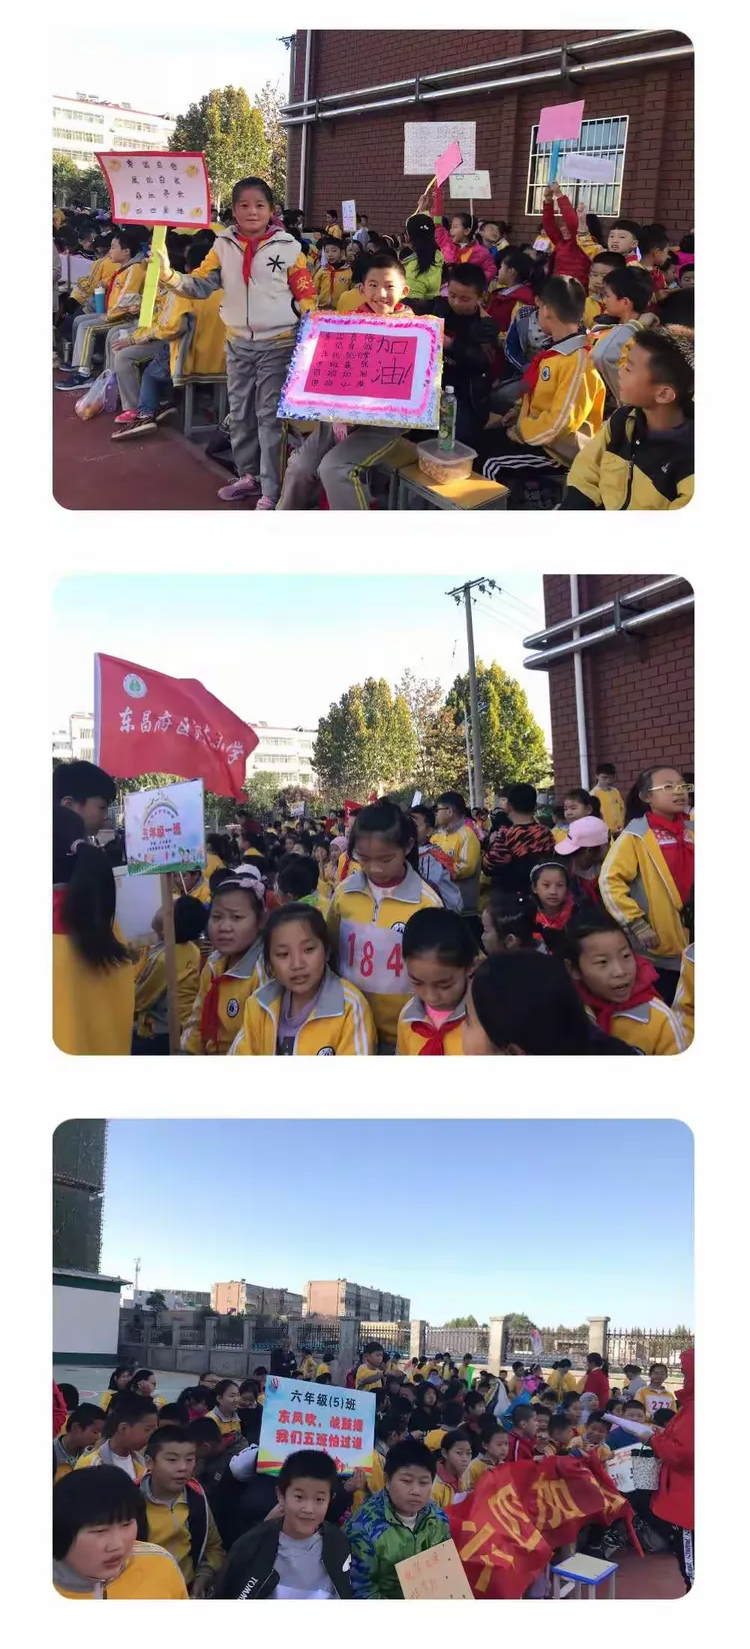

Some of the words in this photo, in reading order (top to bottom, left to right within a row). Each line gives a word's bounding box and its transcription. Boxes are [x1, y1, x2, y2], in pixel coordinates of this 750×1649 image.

[347, 932, 404, 978] 184
[290, 1390, 356, 1411] 六年级(5)班
